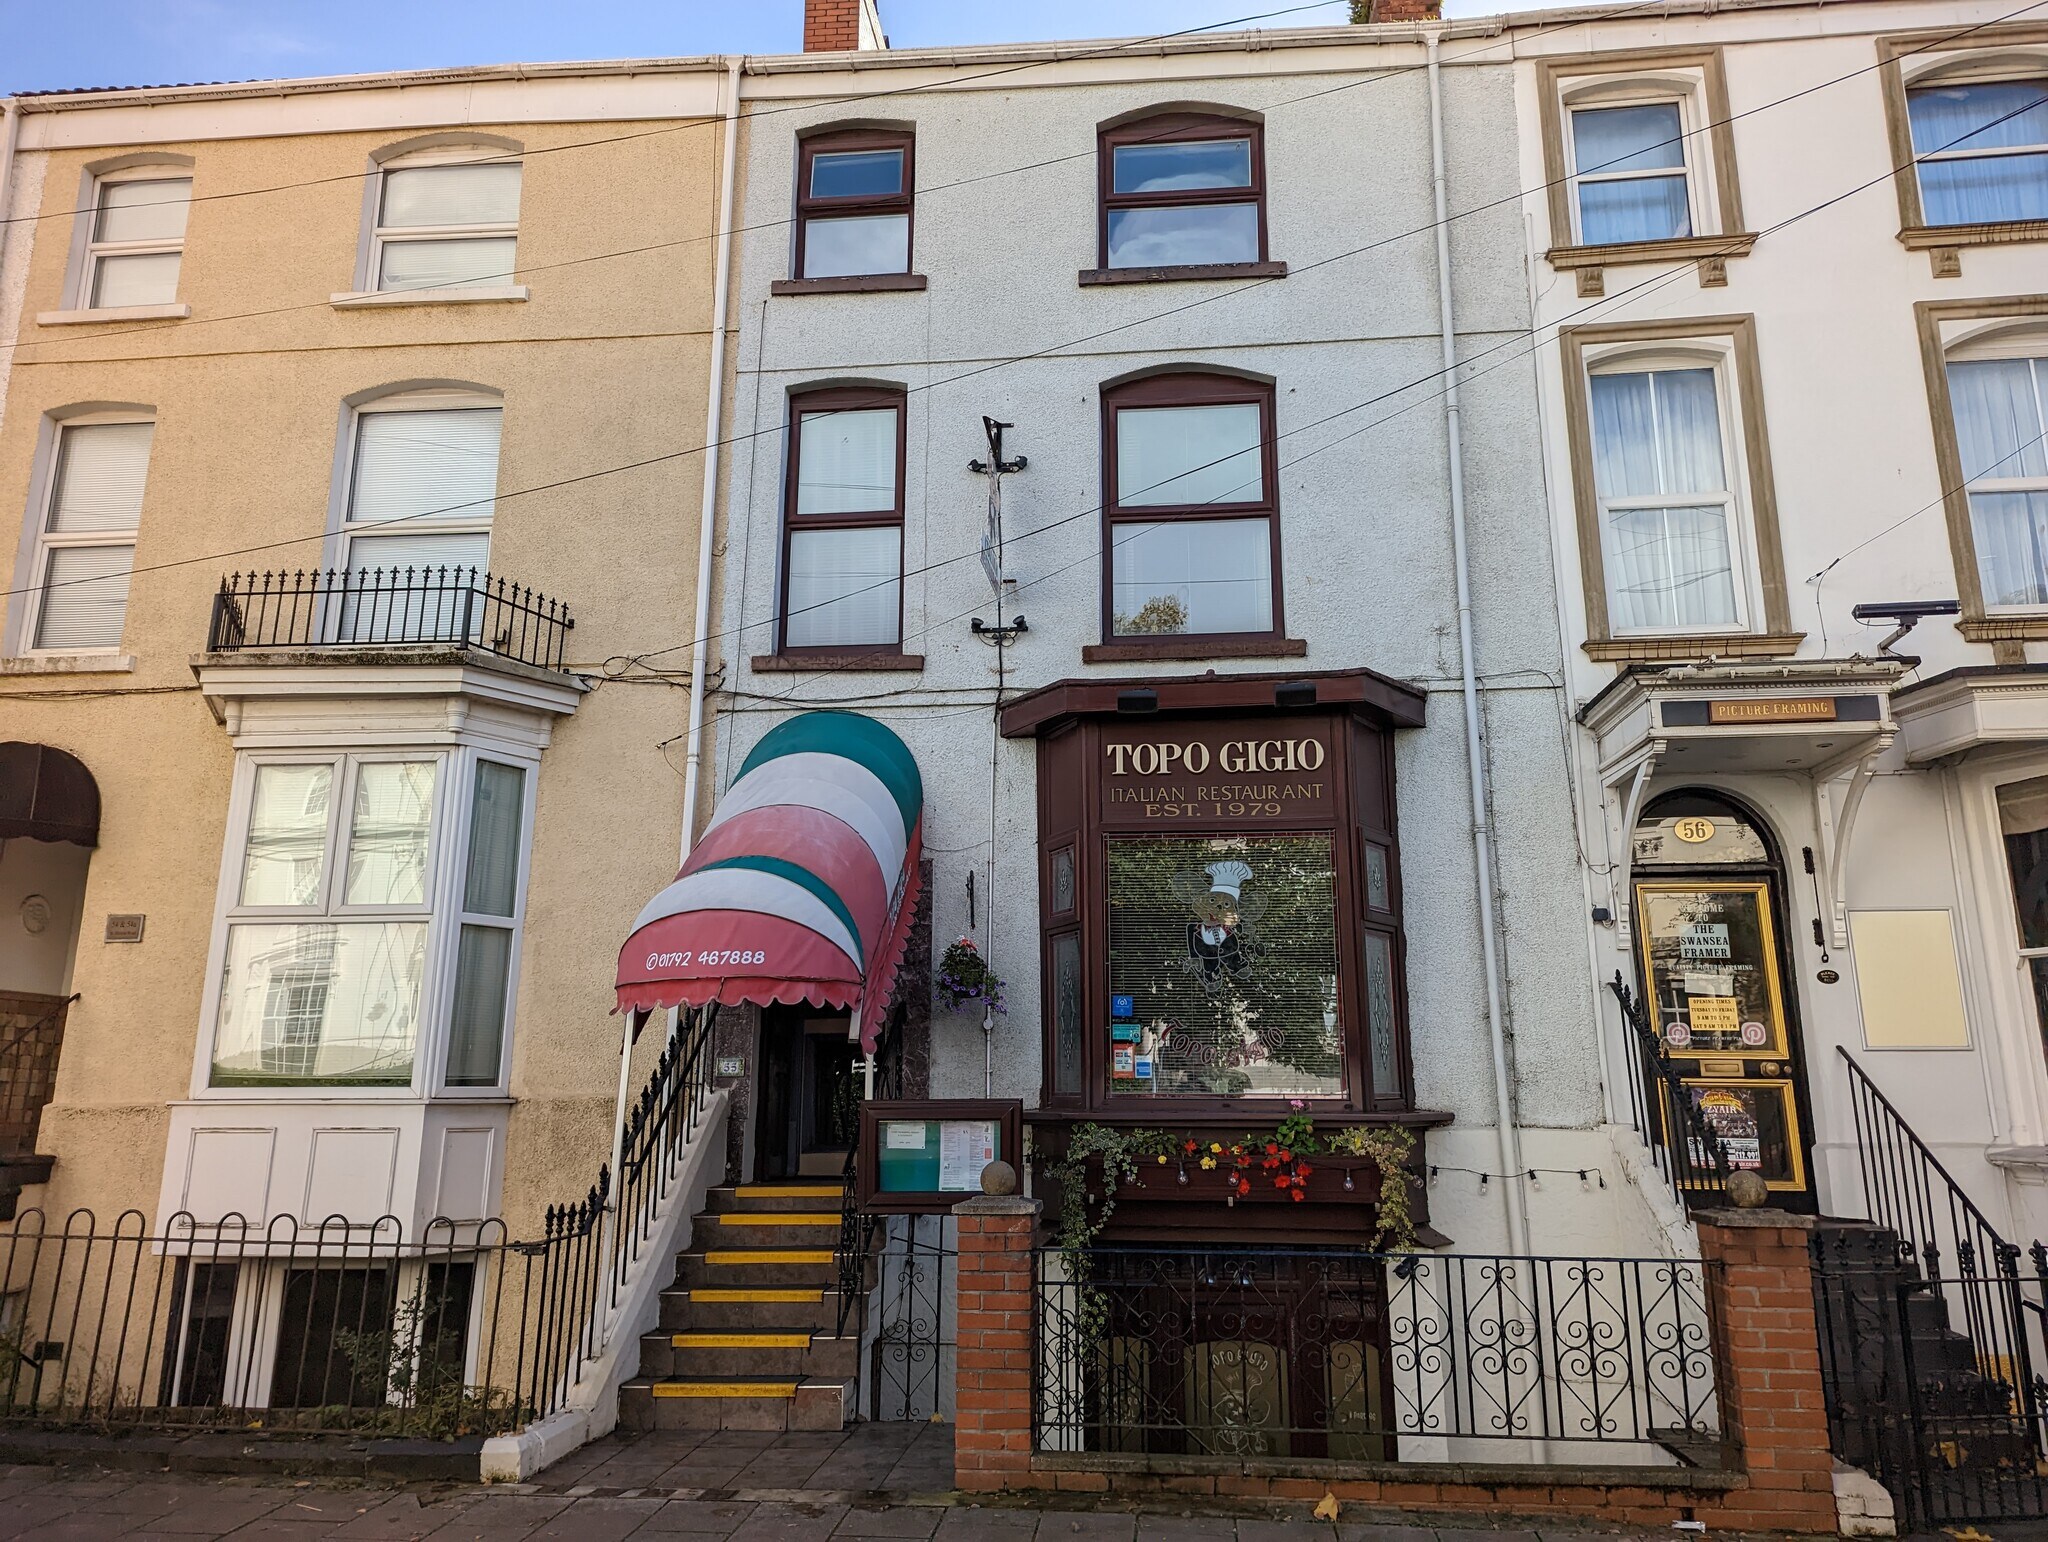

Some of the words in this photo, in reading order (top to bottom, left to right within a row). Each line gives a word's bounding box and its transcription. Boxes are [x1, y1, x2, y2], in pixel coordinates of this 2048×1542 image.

[1718, 704, 1770, 716] PICTURE
[1773, 702, 1828, 714] FRAMING
[1107, 741, 1210, 775] TOPO
[1219, 738, 1325, 774] GIGIO
[1110, 786, 1186, 803] ITALIAN
[1197, 783, 1324, 801] RESTAURANT
[1145, 803, 1201, 817] EST.
[1215, 802, 1282, 817] 1979
[1683, 821, 1706, 839] 56
[1681, 904, 1724, 913] WEOME
[1698, 914, 1708, 922] TO
[1693, 925, 1714, 934] THE
[1681, 936, 1729, 946] SWANSEA
[1684, 948, 1728, 957] FRAMER
[658, 951, 692, 967] 01792
[698, 950, 765, 965] 467888
[723, 1062, 737, 1072] 55
[1707, 1105, 1737, 1114] ZYAIR
